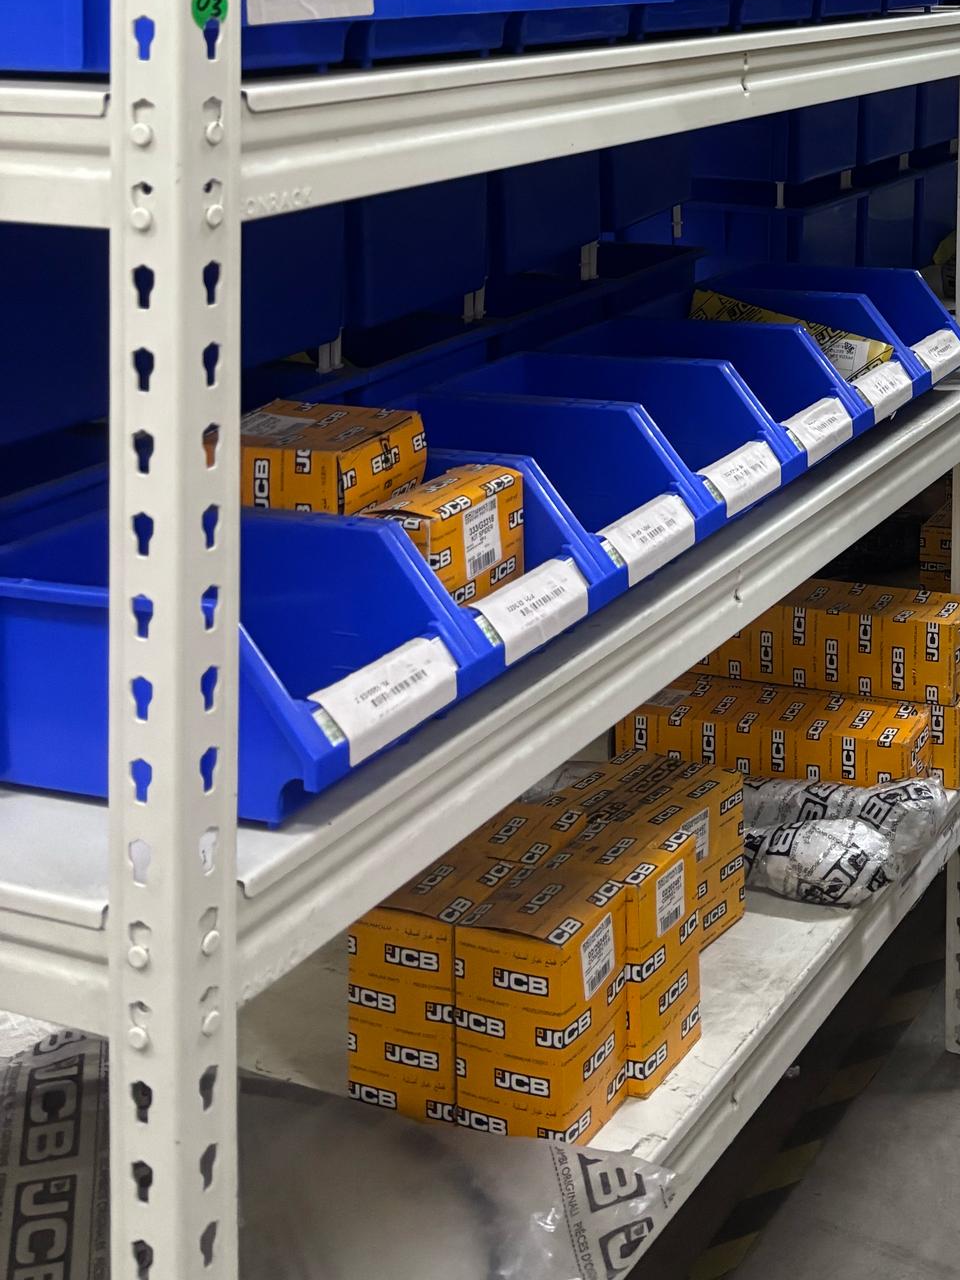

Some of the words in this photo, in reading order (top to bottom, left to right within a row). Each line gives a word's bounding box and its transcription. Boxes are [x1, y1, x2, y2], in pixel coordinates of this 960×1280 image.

[485, 474, 515, 497] JCB
[438, 496, 472, 520] JCB
[430, 548, 452, 570] CB
[490, 556, 517, 585] JCB
[938, 601, 959, 619] JCB
[761, 631, 773, 674] JCB
[826, 639, 838, 682] JCB
[892, 647, 905, 691] JCB
[713, 696, 737, 715] JCB
[783, 702, 805, 722] JCB
[851, 710, 873, 730] JCB
[703, 722, 715, 764] JCB
[772, 729, 785, 772] JCB
[689, 780, 719, 799] JCB
[721, 790, 743, 815] JCB
[492, 817, 526, 844] JCB
[522, 844, 549, 865] CB
[598, 838, 636, 864] JCB
[625, 863, 657, 885] CB
[721, 856, 743, 881] JCB
[440, 898, 474, 923] CB
[527, 883, 563, 914] JCB
[704, 902, 727, 930] JCB
[550, 918, 582, 943] CB
[386, 945, 439, 970] JCB
[493, 969, 549, 995] JCB
[659, 972, 688, 1015] JCB
[349, 987, 396, 1012] JCB
[455, 1009, 505, 1037] JCB
[386, 1045, 439, 1070] JCB
[584, 1034, 615, 1080] JCB
[349, 1083, 397, 1108] JCB
[495, 1070, 550, 1097] JCB
[456, 1107, 507, 1135] JCB
[14, 1175, 72, 1280] JC
